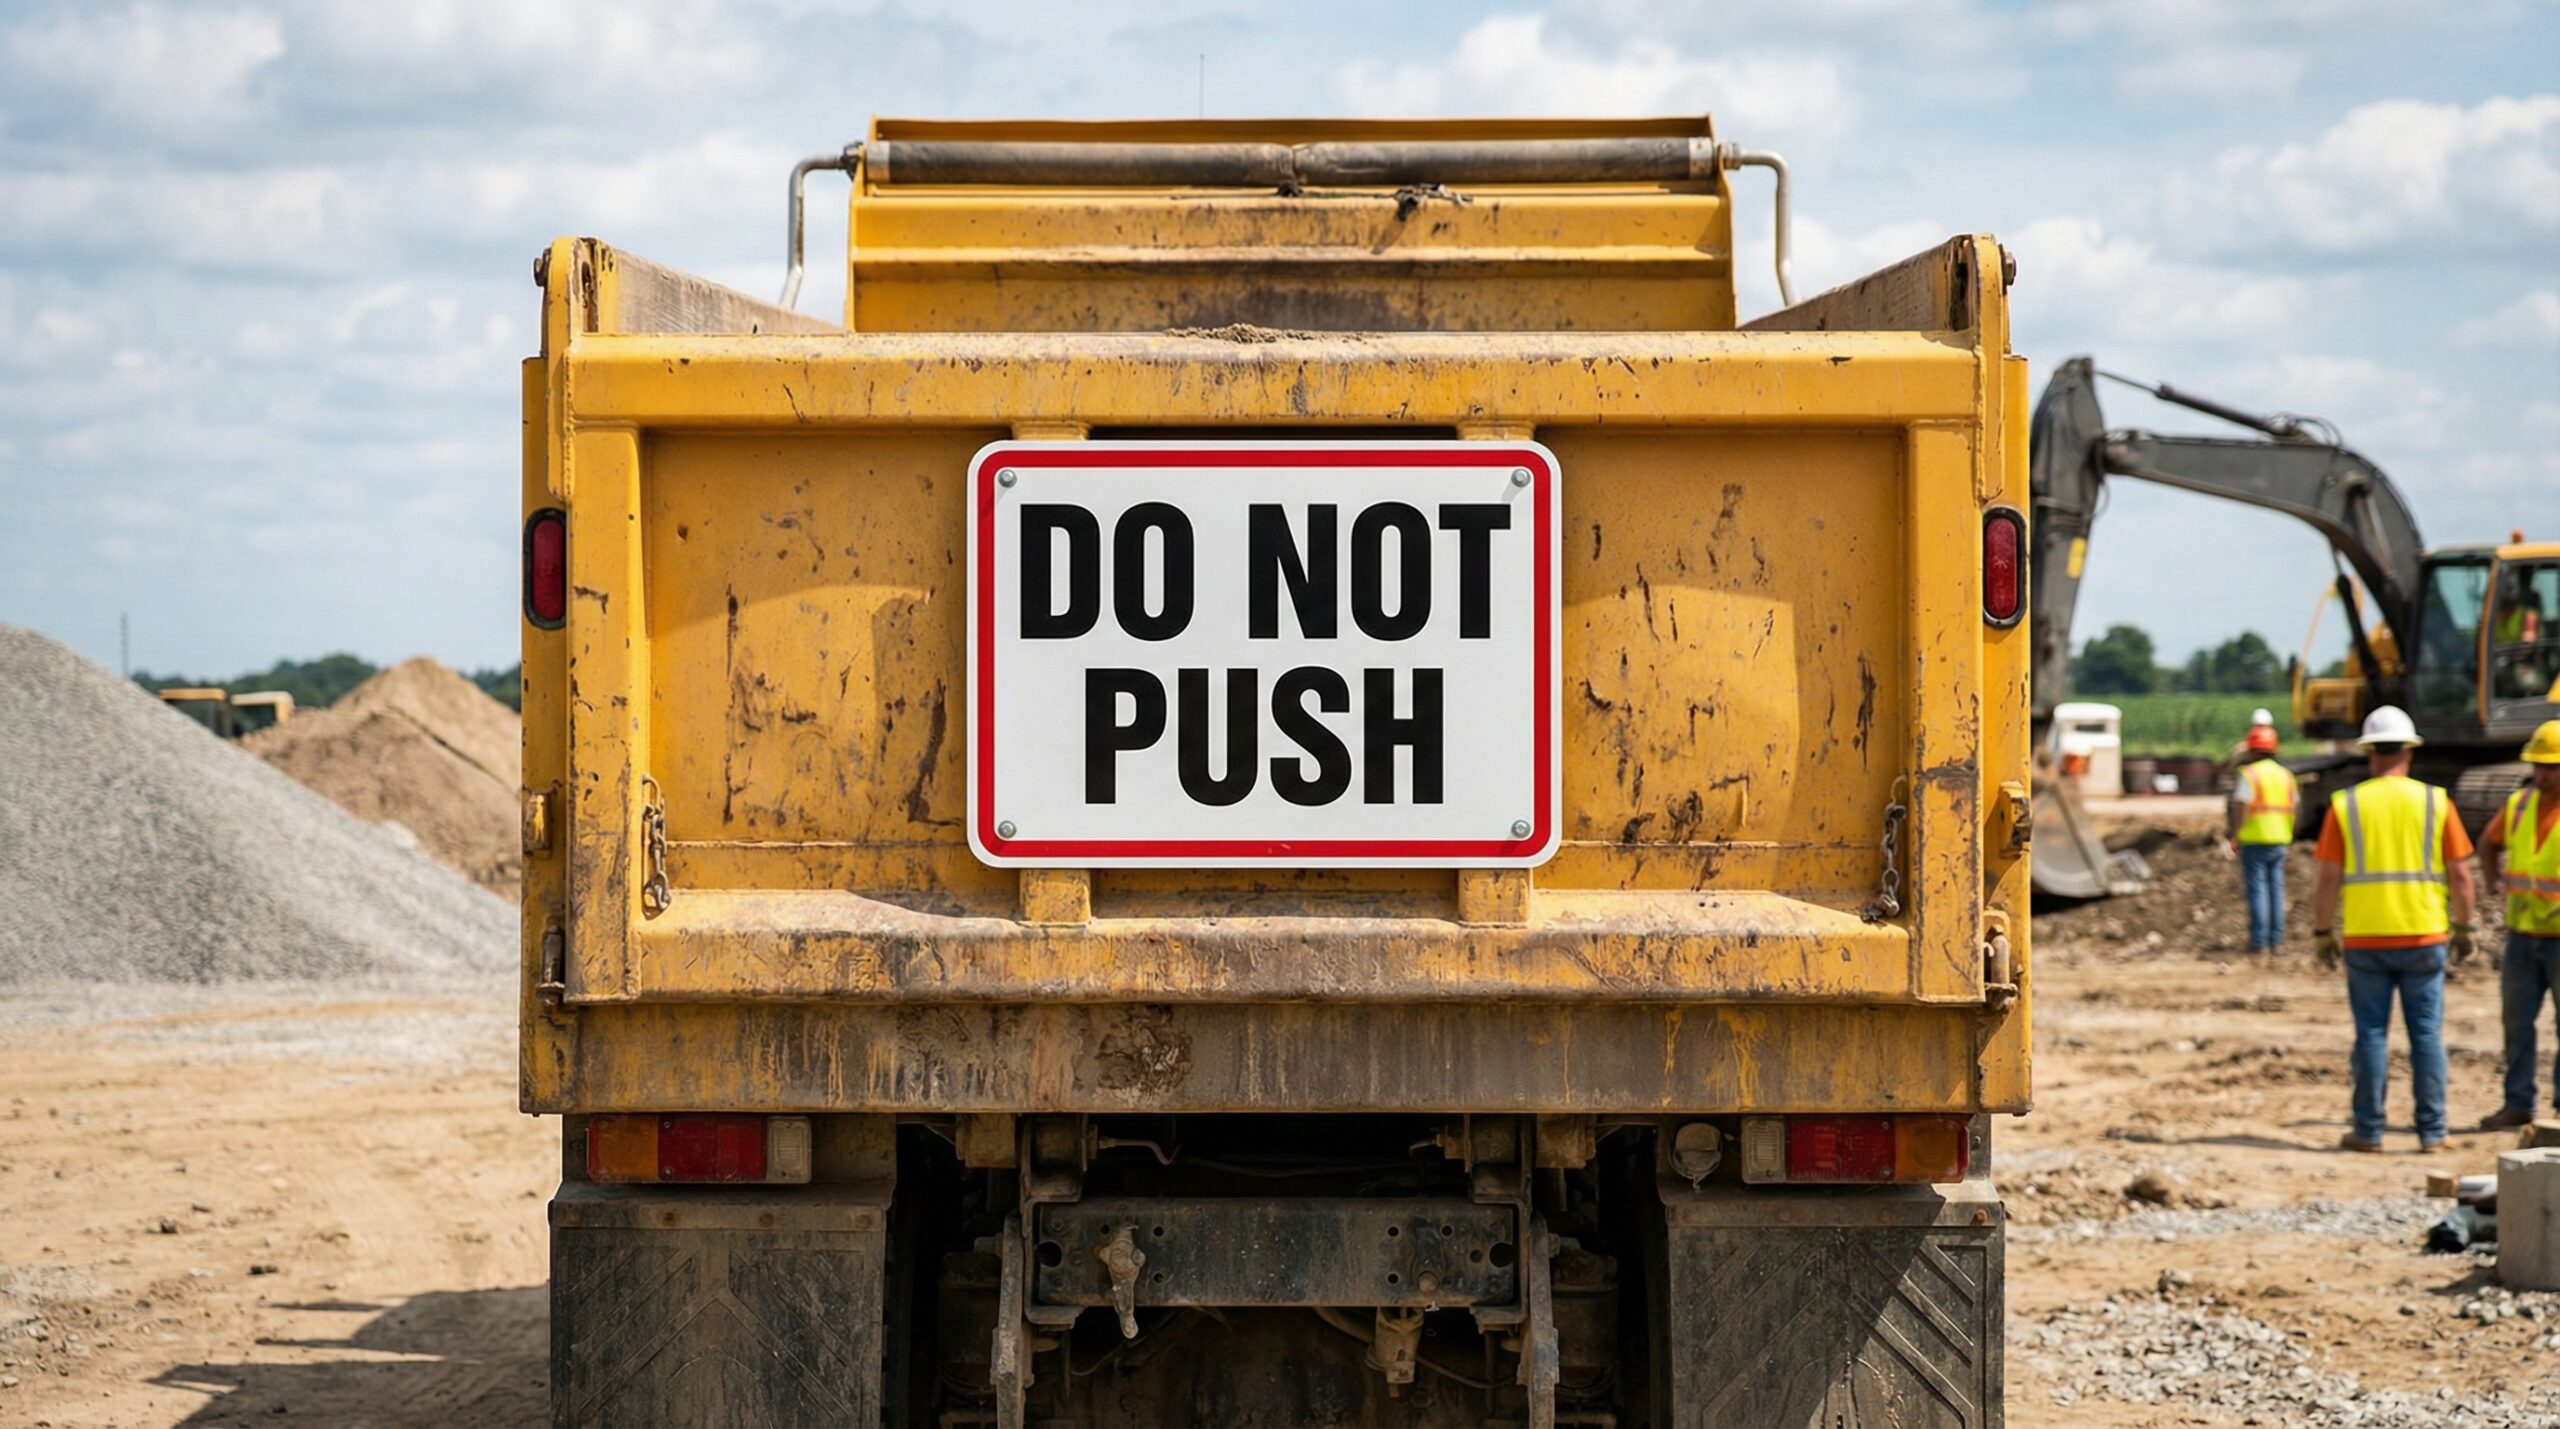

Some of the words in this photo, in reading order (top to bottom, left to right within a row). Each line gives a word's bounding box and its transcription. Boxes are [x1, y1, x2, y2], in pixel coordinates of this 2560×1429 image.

[1020, 501, 1195, 642] DO
[1248, 501, 1512, 642] NOT
[1084, 666, 1444, 807] PUSH
